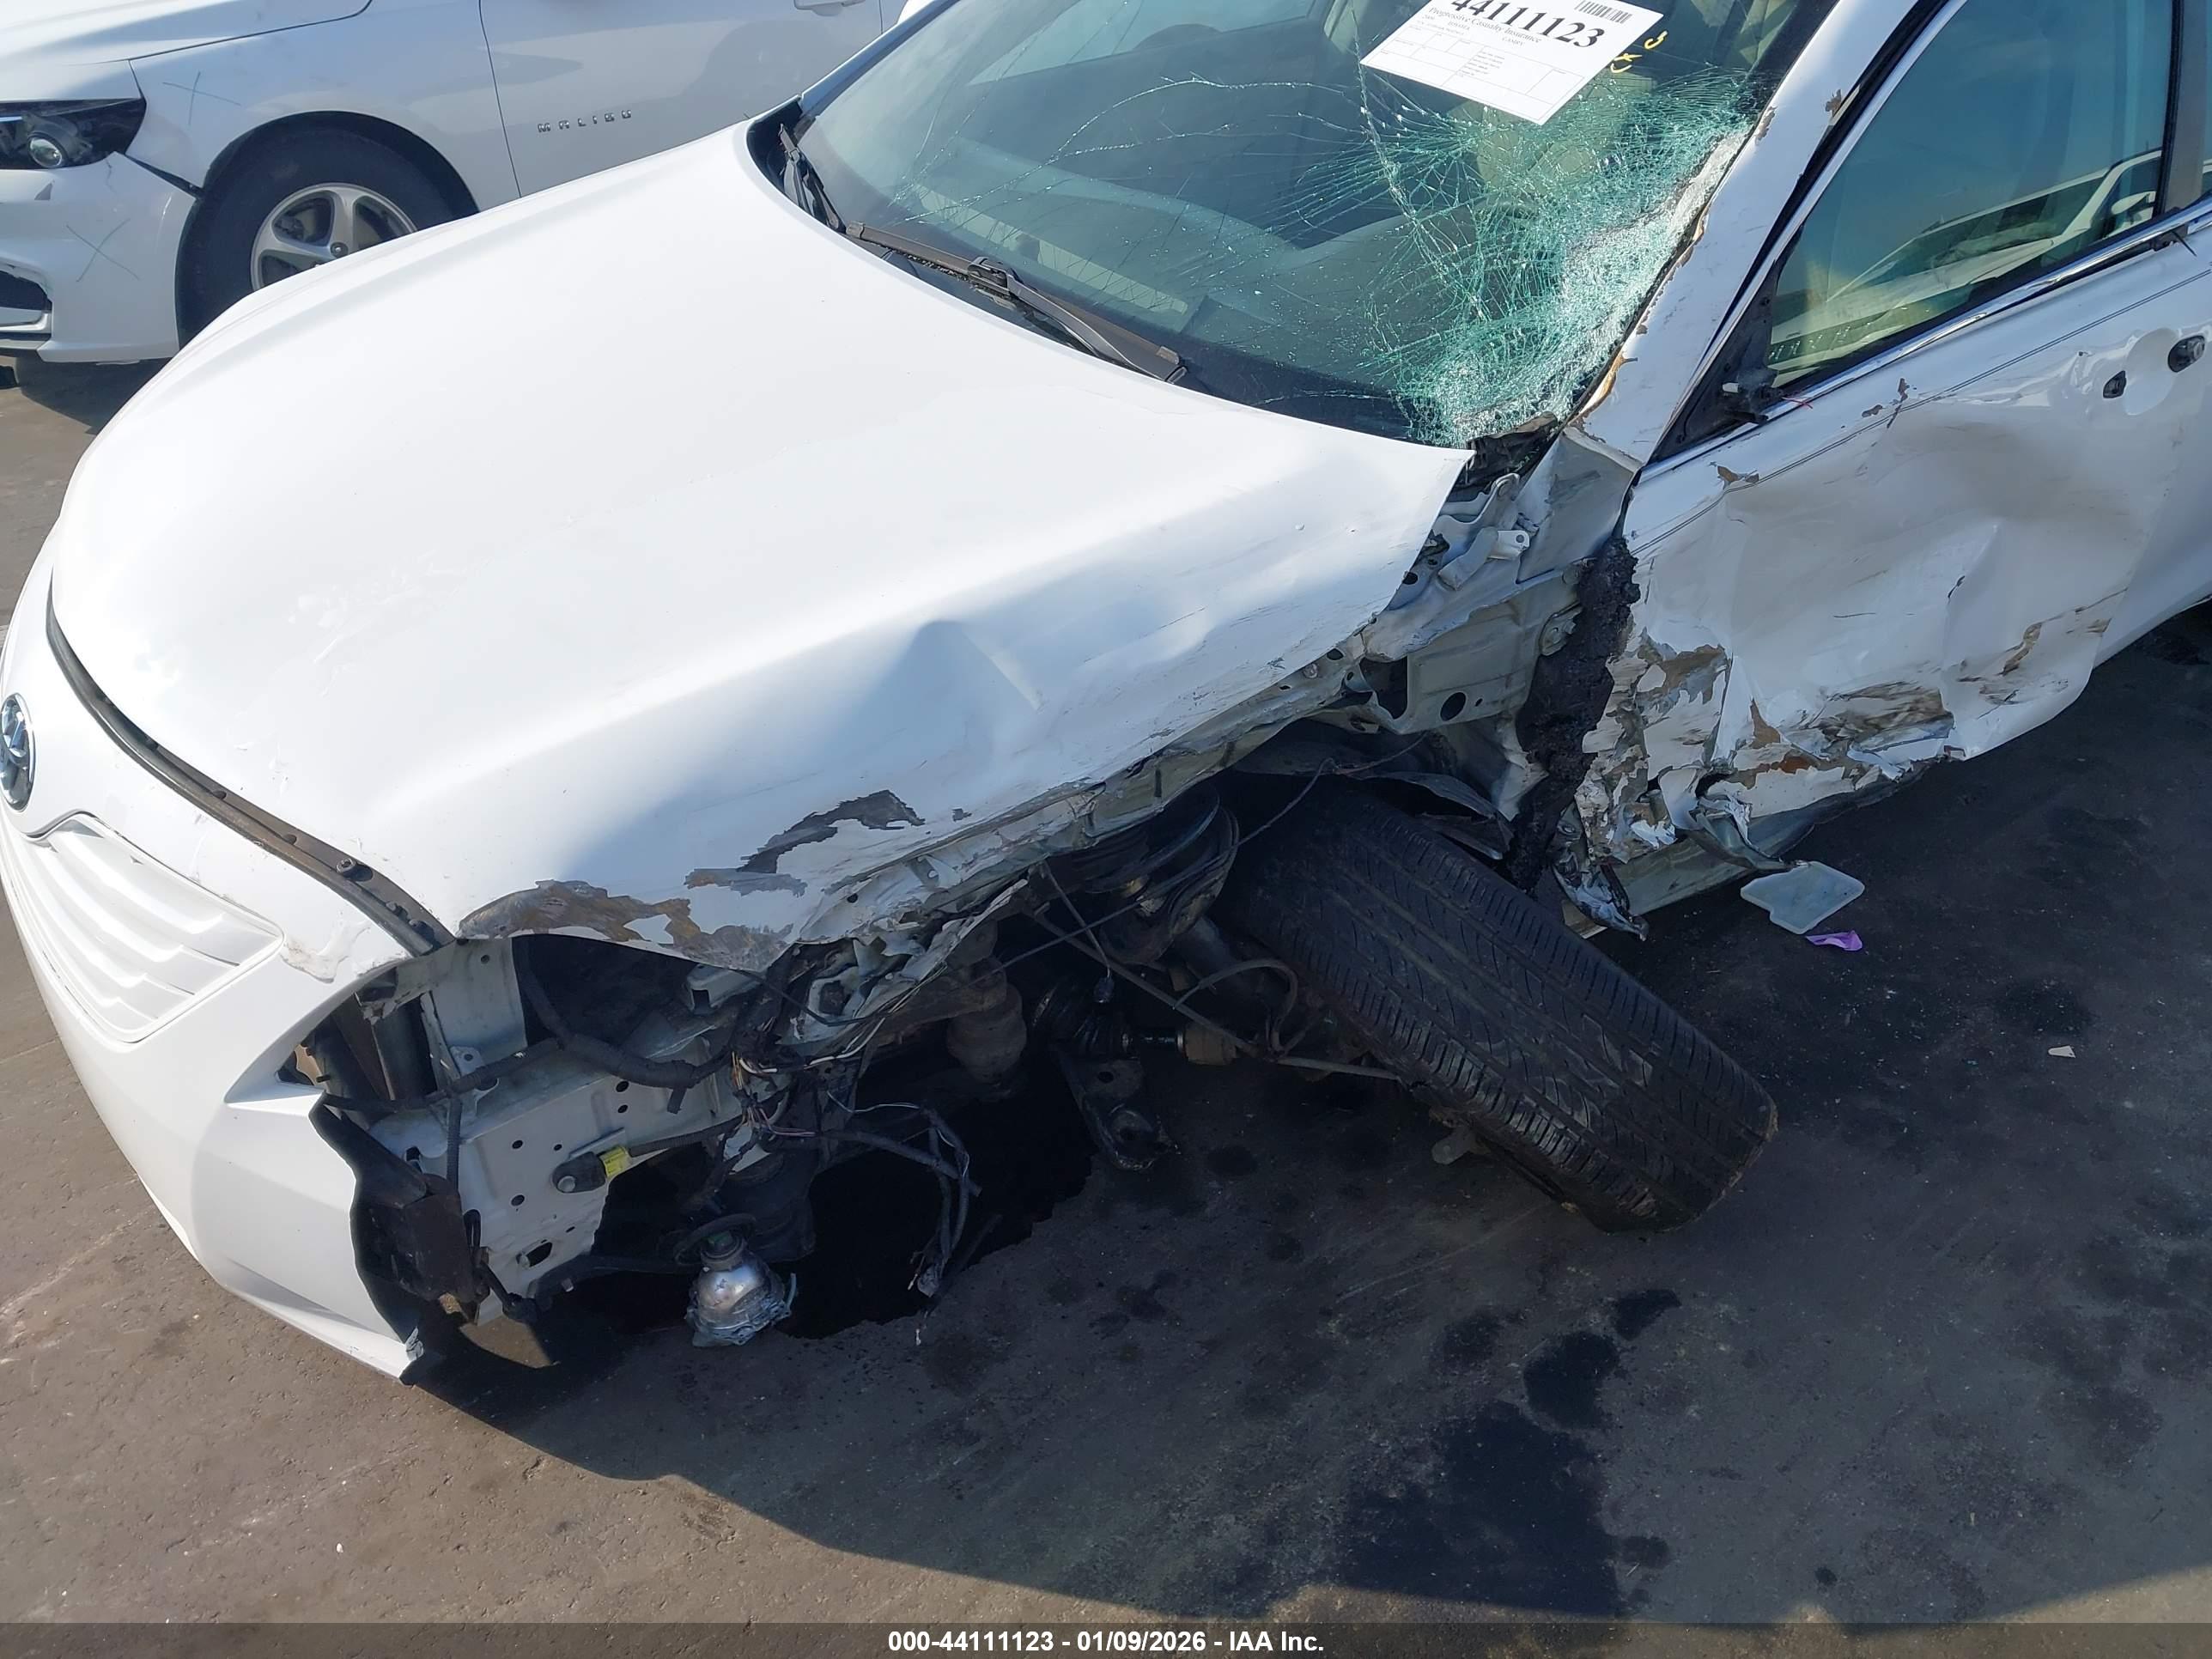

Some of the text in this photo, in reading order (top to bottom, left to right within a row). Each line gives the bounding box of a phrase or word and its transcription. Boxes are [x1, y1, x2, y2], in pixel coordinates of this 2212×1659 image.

[1429, 7, 1471, 23] Progressive
[1471, 18, 1504, 33] Casualty
[1504, 27, 1542, 44] Insurance
[1451, 0, 1605, 48] 44111123
[537, 109, 632, 133] MALIBU
